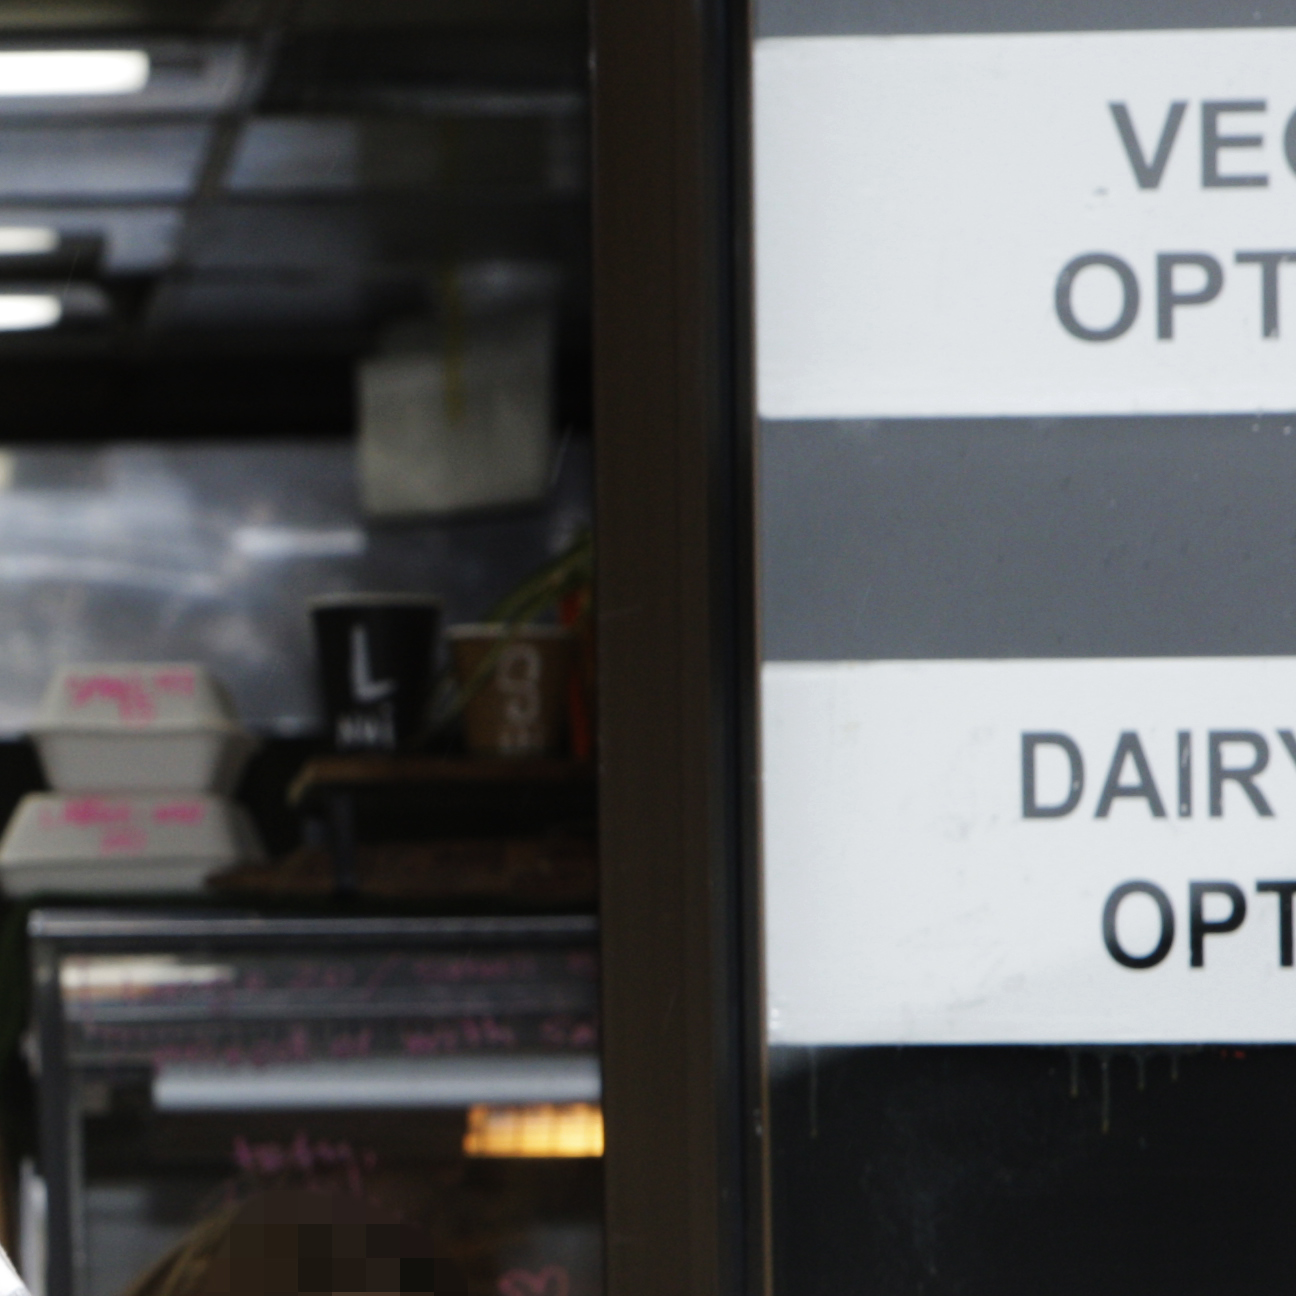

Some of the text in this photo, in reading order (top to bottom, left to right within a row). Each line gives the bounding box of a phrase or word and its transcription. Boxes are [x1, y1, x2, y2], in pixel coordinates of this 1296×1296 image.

[1108, 98, 1296, 191] VE
[1054, 250, 1296, 342] OPT
[1019, 730, 1296, 819] DAIR
